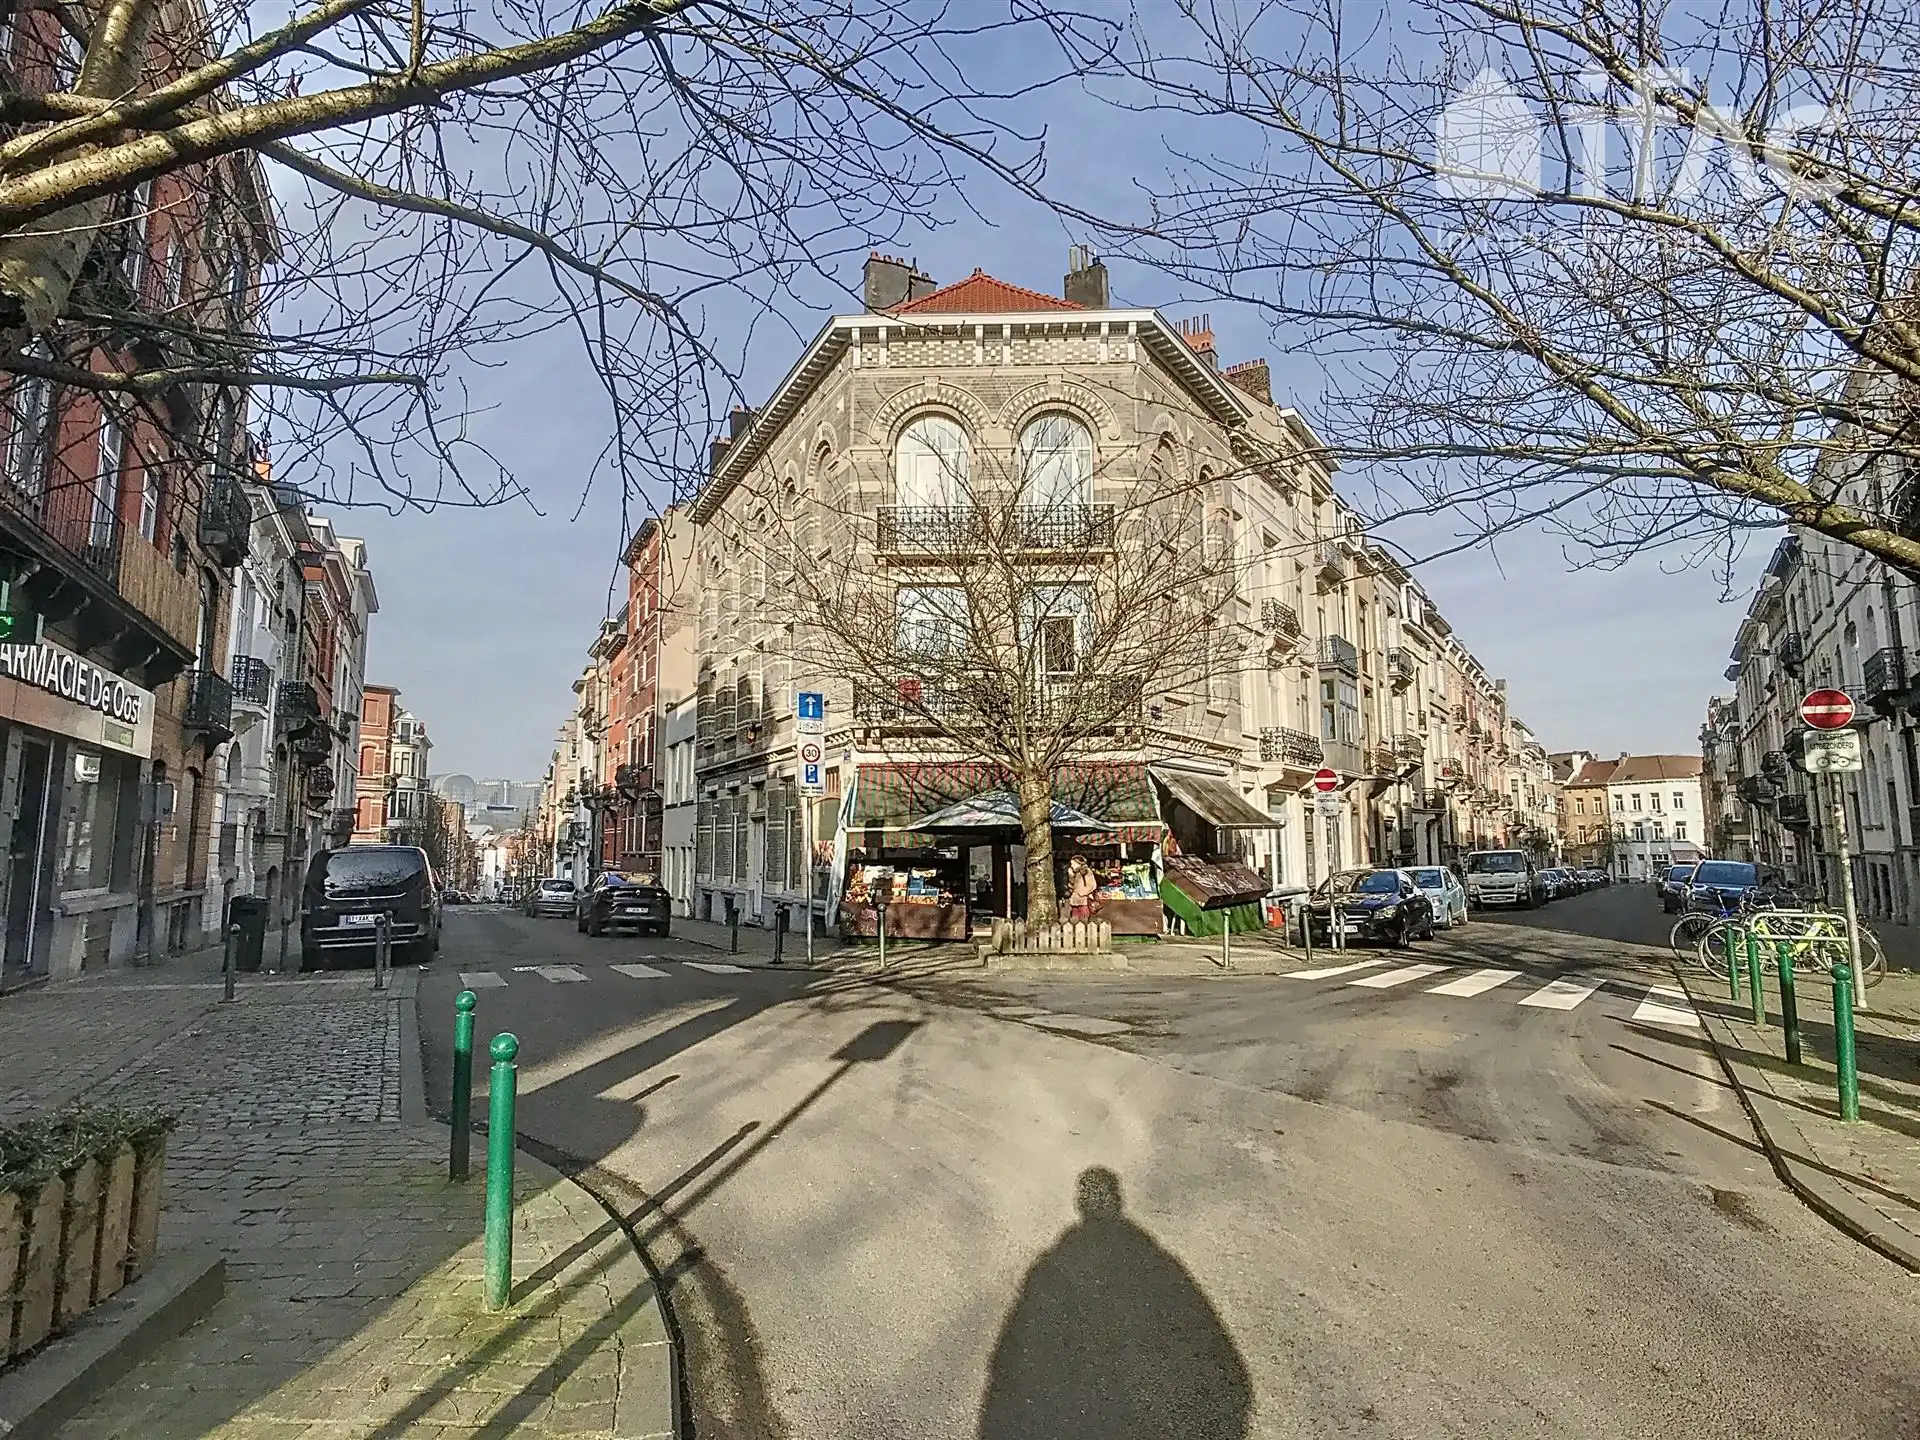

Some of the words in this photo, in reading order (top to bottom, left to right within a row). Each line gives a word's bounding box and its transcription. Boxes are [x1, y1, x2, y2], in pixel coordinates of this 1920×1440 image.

[91, 669, 110, 711] De
[113, 681, 143, 725] Oost
[806, 749, 817, 758] 30
[808, 765, 815, 776] P
